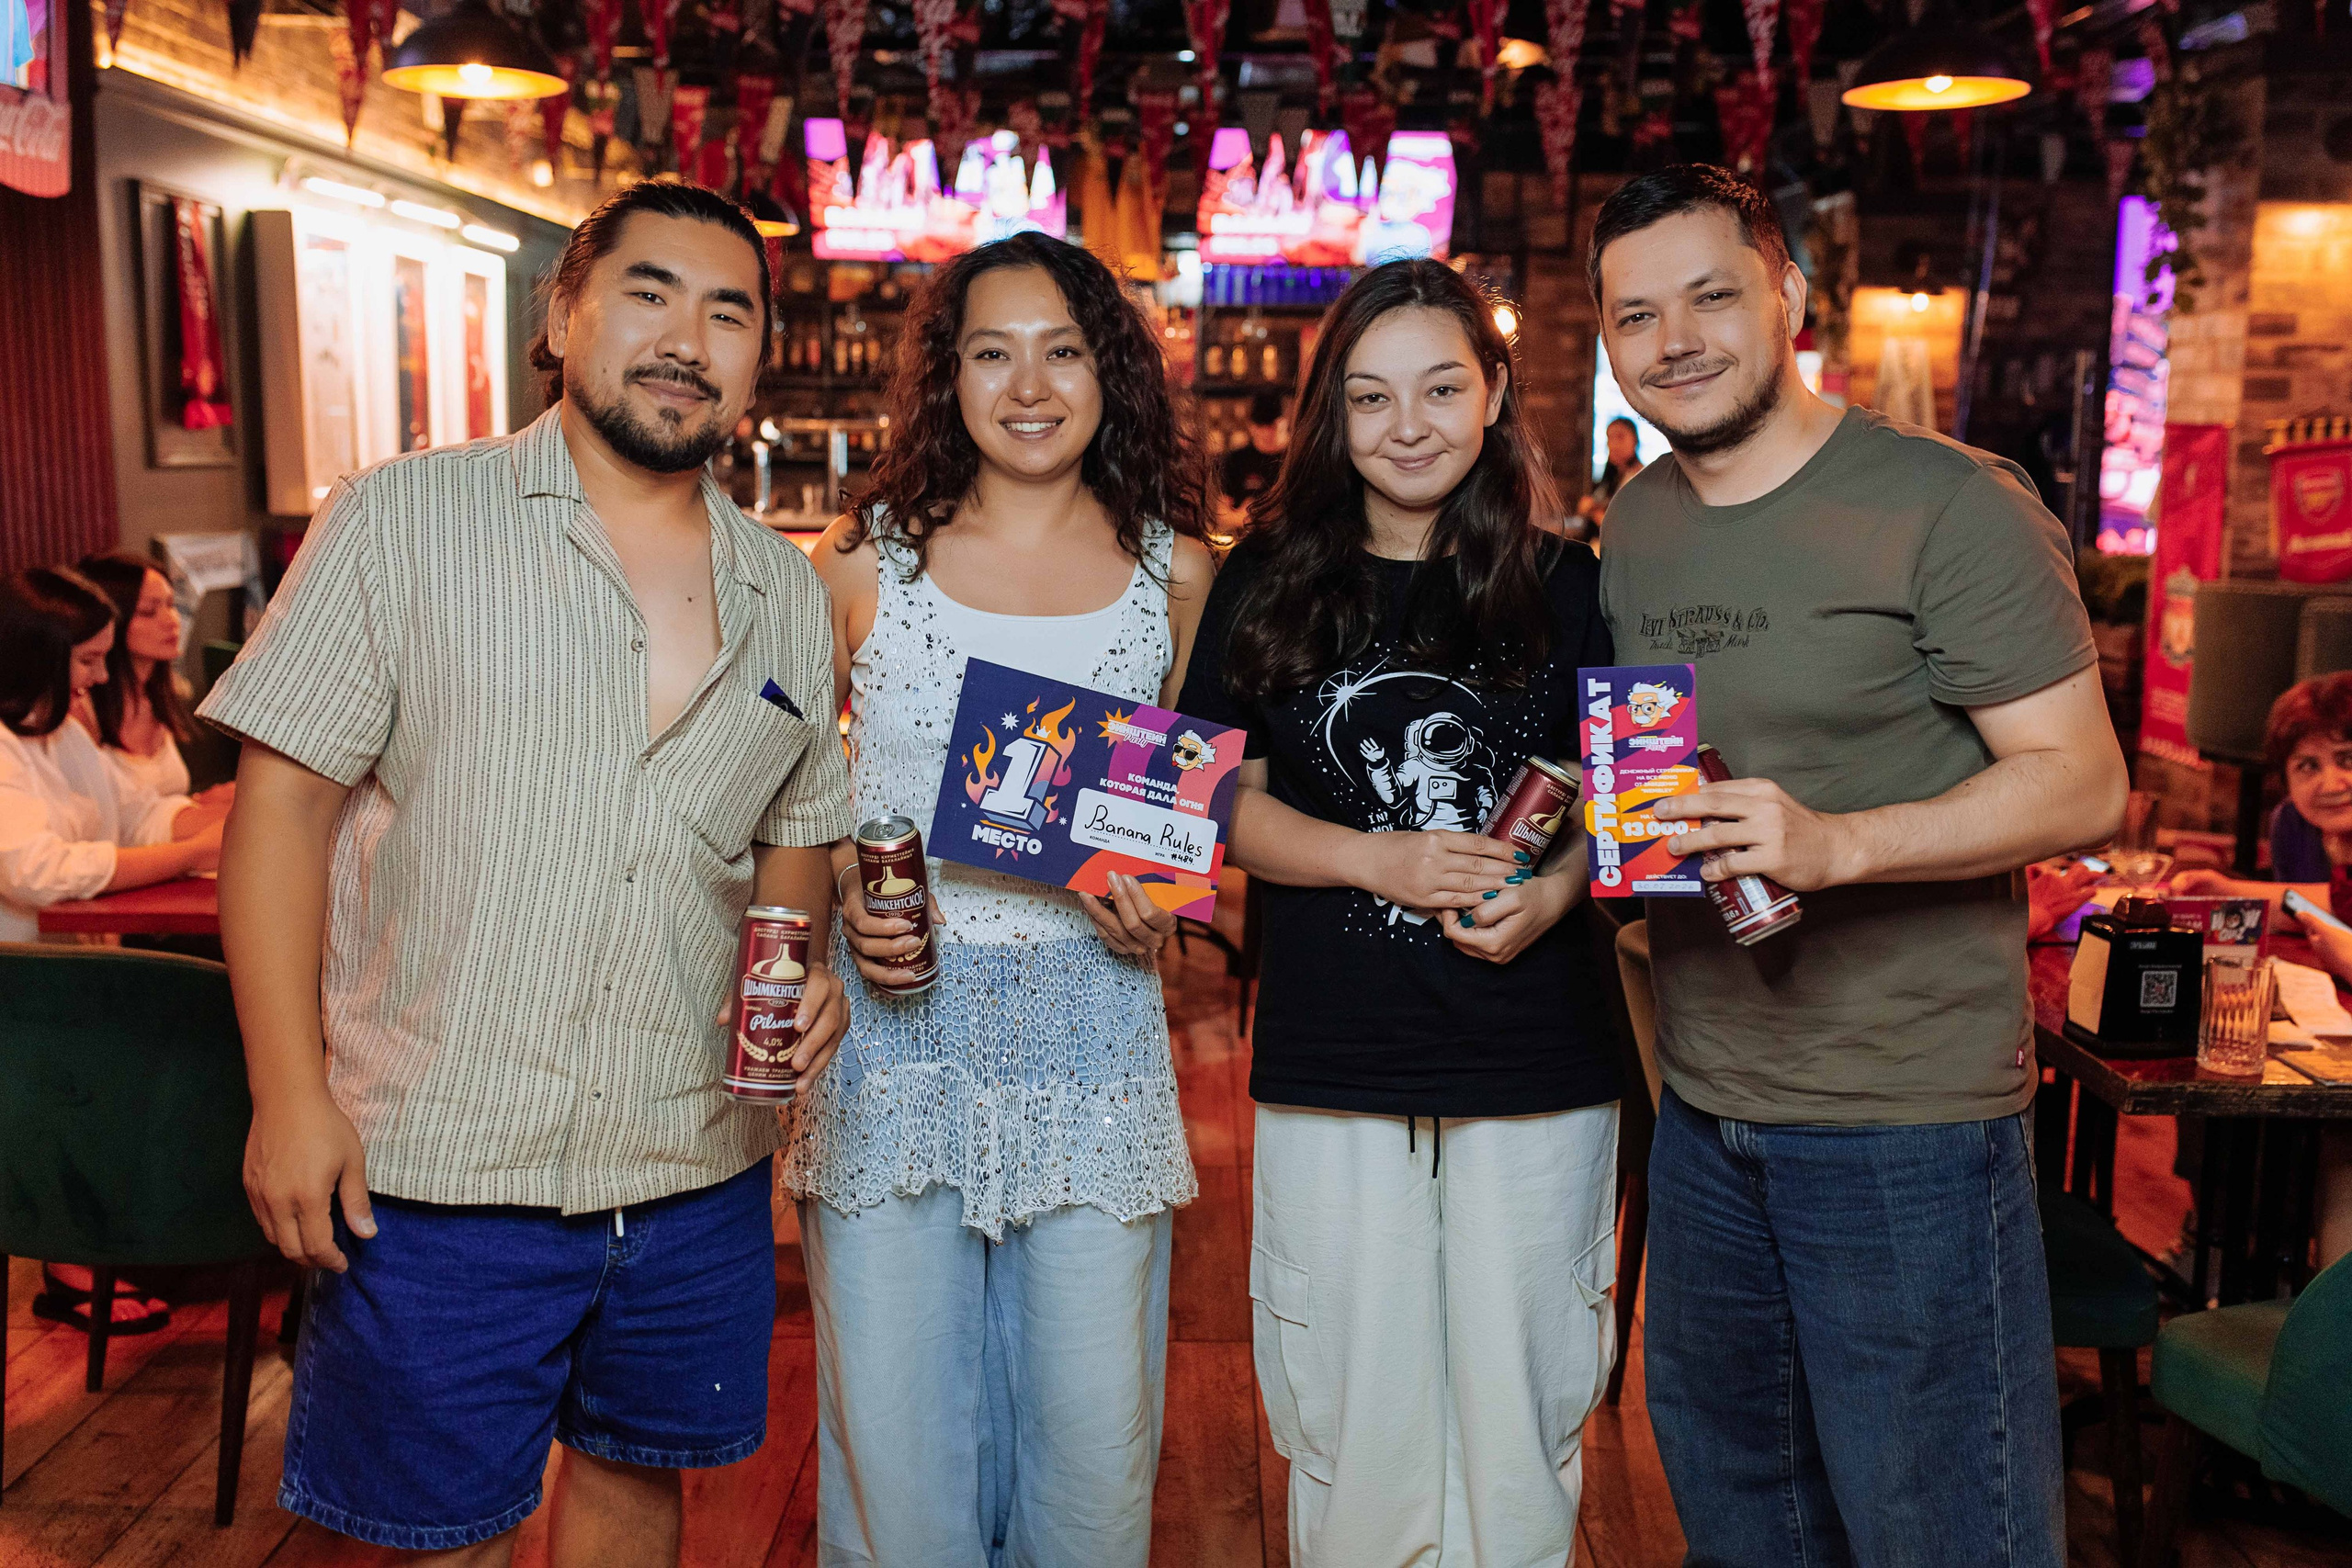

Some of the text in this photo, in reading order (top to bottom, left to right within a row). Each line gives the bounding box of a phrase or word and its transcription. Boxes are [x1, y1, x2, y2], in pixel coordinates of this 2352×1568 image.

[979, 738, 1049, 821] 1
[1099, 778, 1204, 811] КОТОРАЯ ДАЛА ОГНЯ
[1587, 678, 1623, 887] СЕРТИФИКАТ
[971, 824, 1043, 855] МЕСТО
[1084, 804, 1203, 857] Banana Rules
[1089, 835, 1110, 843] КОМАНДА
[1622, 820, 1689, 837] 13 000
[865, 889, 924, 910] ШЫМКЕНТСКОЕ
[763, 1037, 783, 1047] 4,0%
